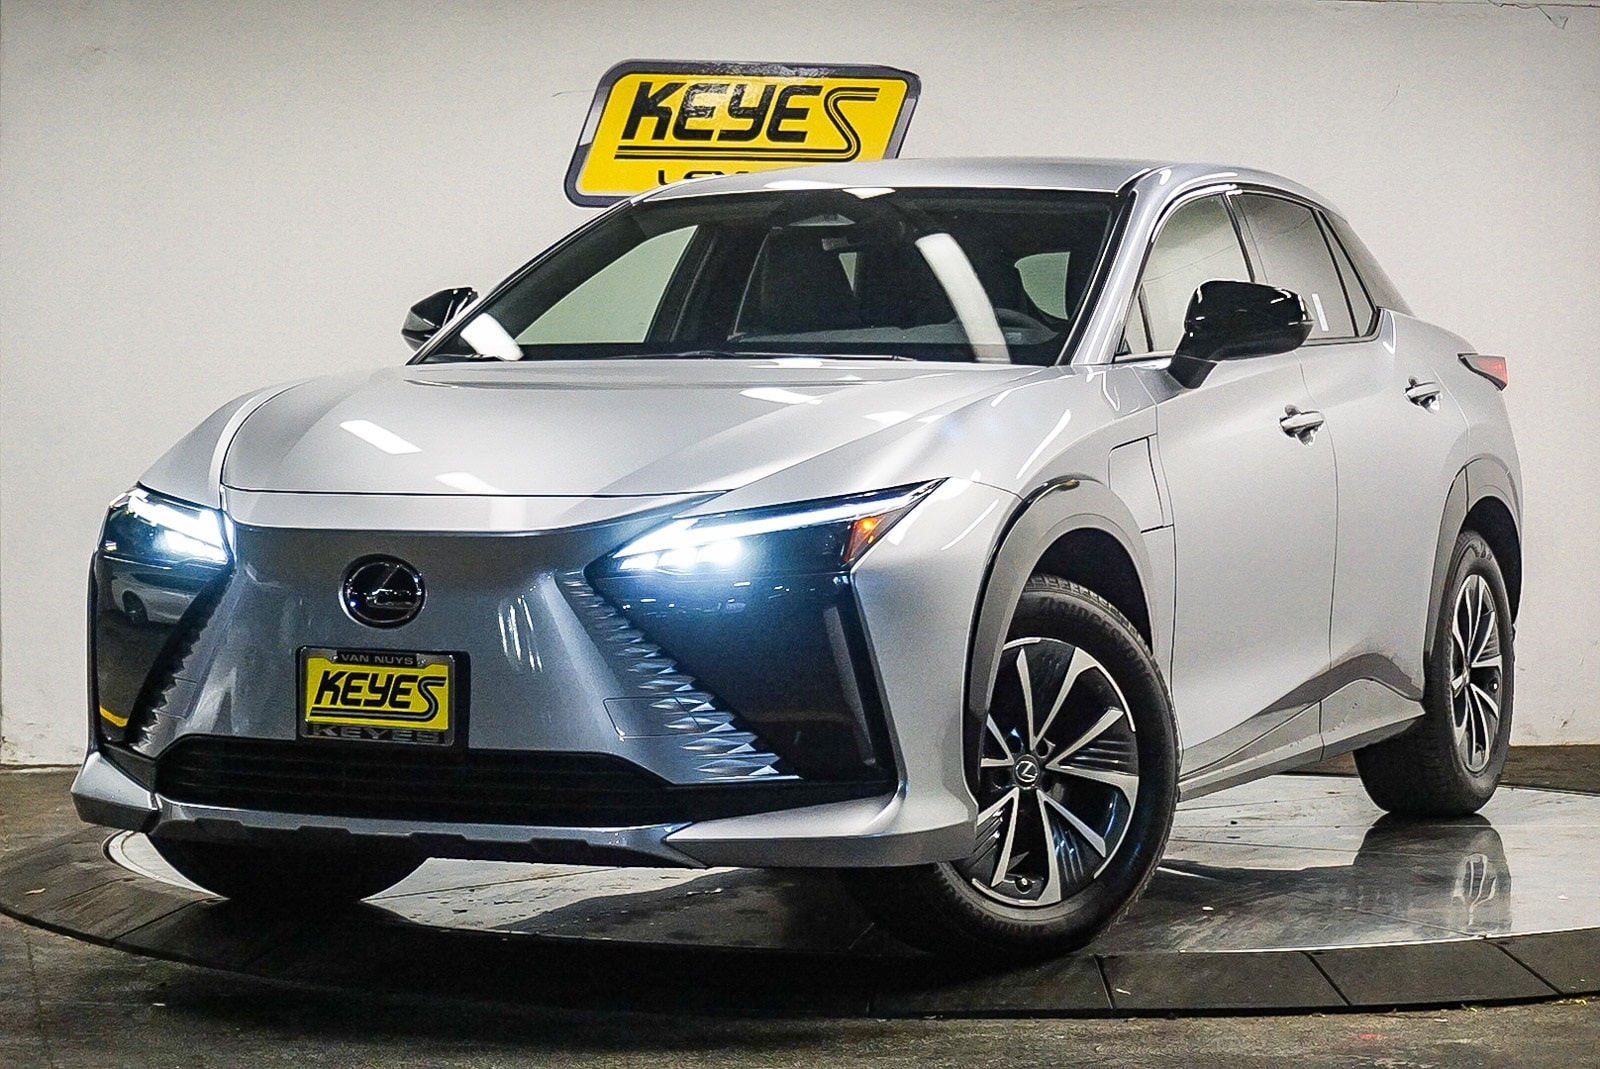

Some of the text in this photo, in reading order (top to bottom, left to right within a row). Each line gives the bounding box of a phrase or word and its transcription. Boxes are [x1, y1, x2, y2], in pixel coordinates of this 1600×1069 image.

[614, 81, 881, 162] KEYES
[340, 653, 414, 666] VAN NUYS
[310, 669, 447, 722] KEYES
[312, 724, 441, 744] KEYES
